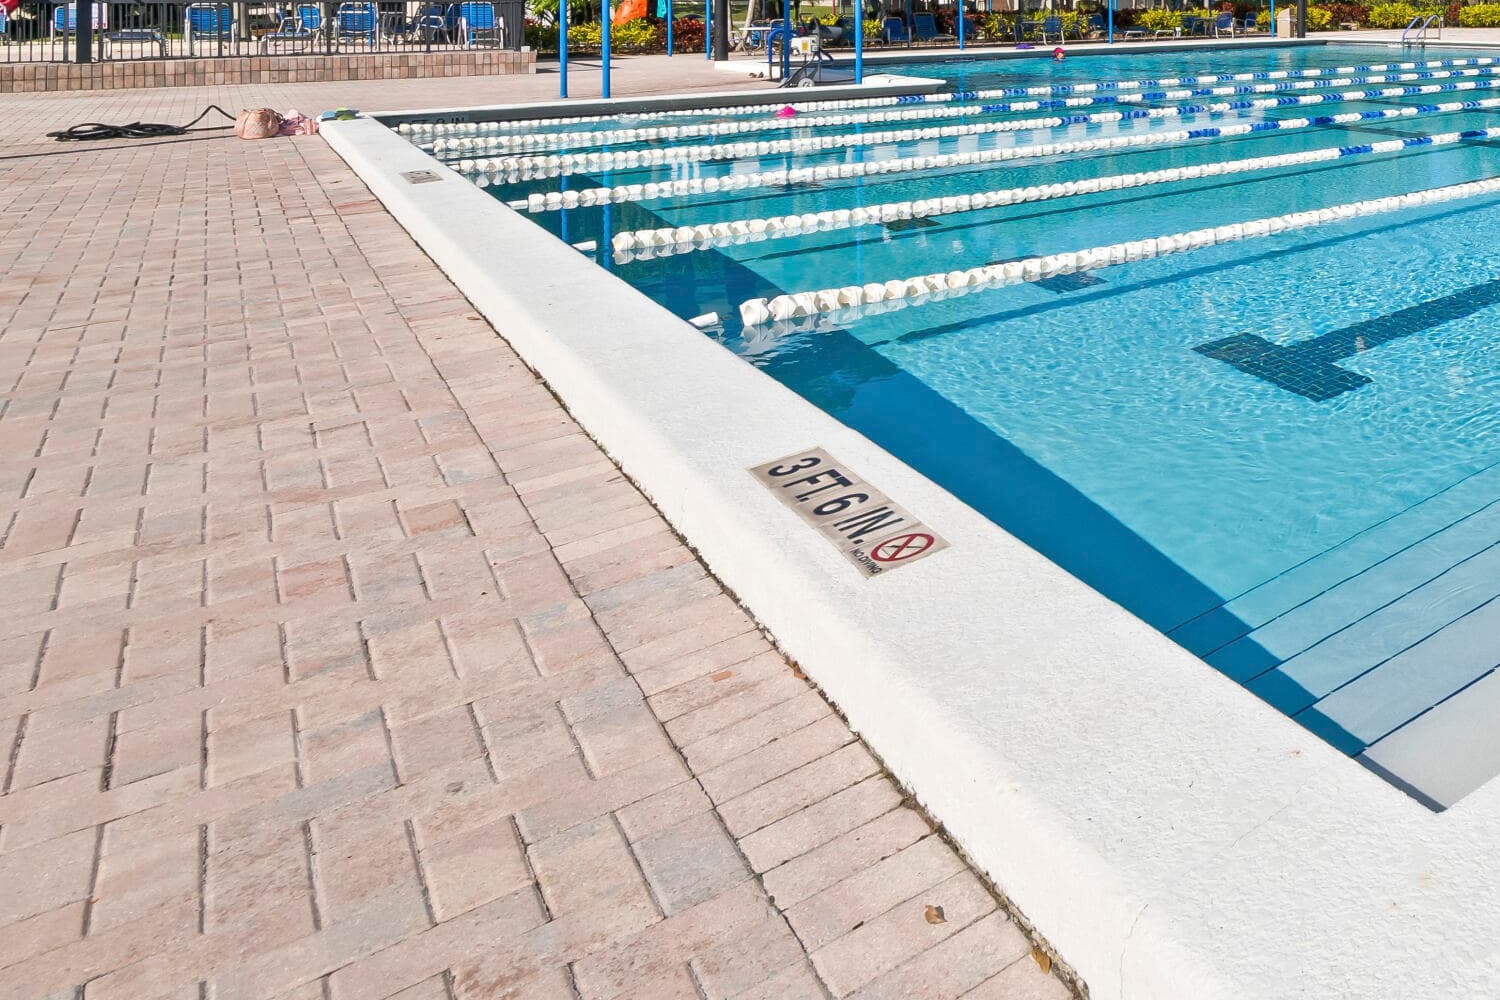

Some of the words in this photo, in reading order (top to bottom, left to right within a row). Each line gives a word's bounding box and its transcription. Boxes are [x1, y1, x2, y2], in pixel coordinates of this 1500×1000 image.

[767, 456, 822, 477] 3
[813, 492, 870, 516] 6
[832, 506, 905, 545] IN.
[849, 548, 864, 557] NO
[858, 556, 882, 574] DIVING
